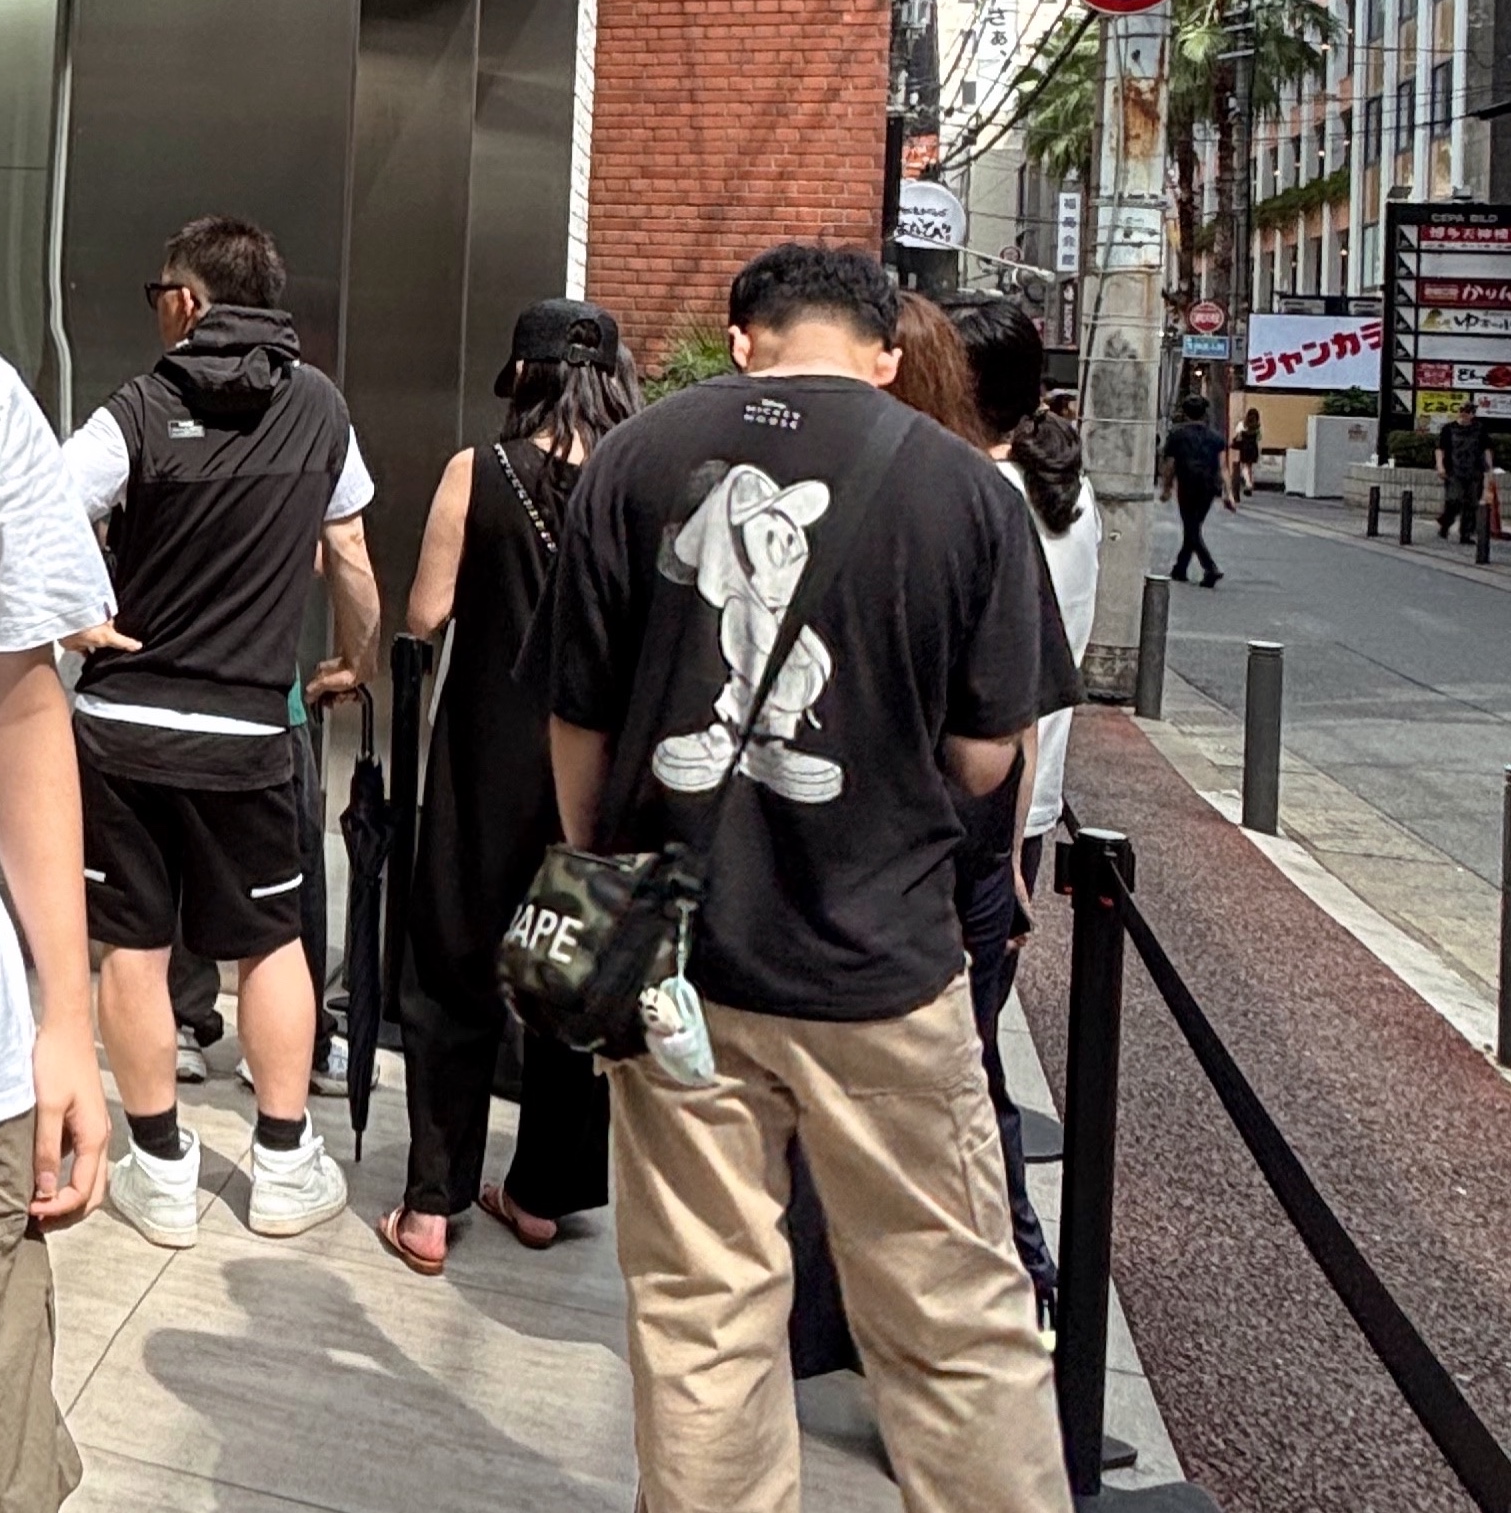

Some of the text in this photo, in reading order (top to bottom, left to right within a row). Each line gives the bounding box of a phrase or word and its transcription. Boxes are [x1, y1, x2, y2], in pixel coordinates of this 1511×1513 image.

[1249, 321, 1381, 383] ジャンカラ
